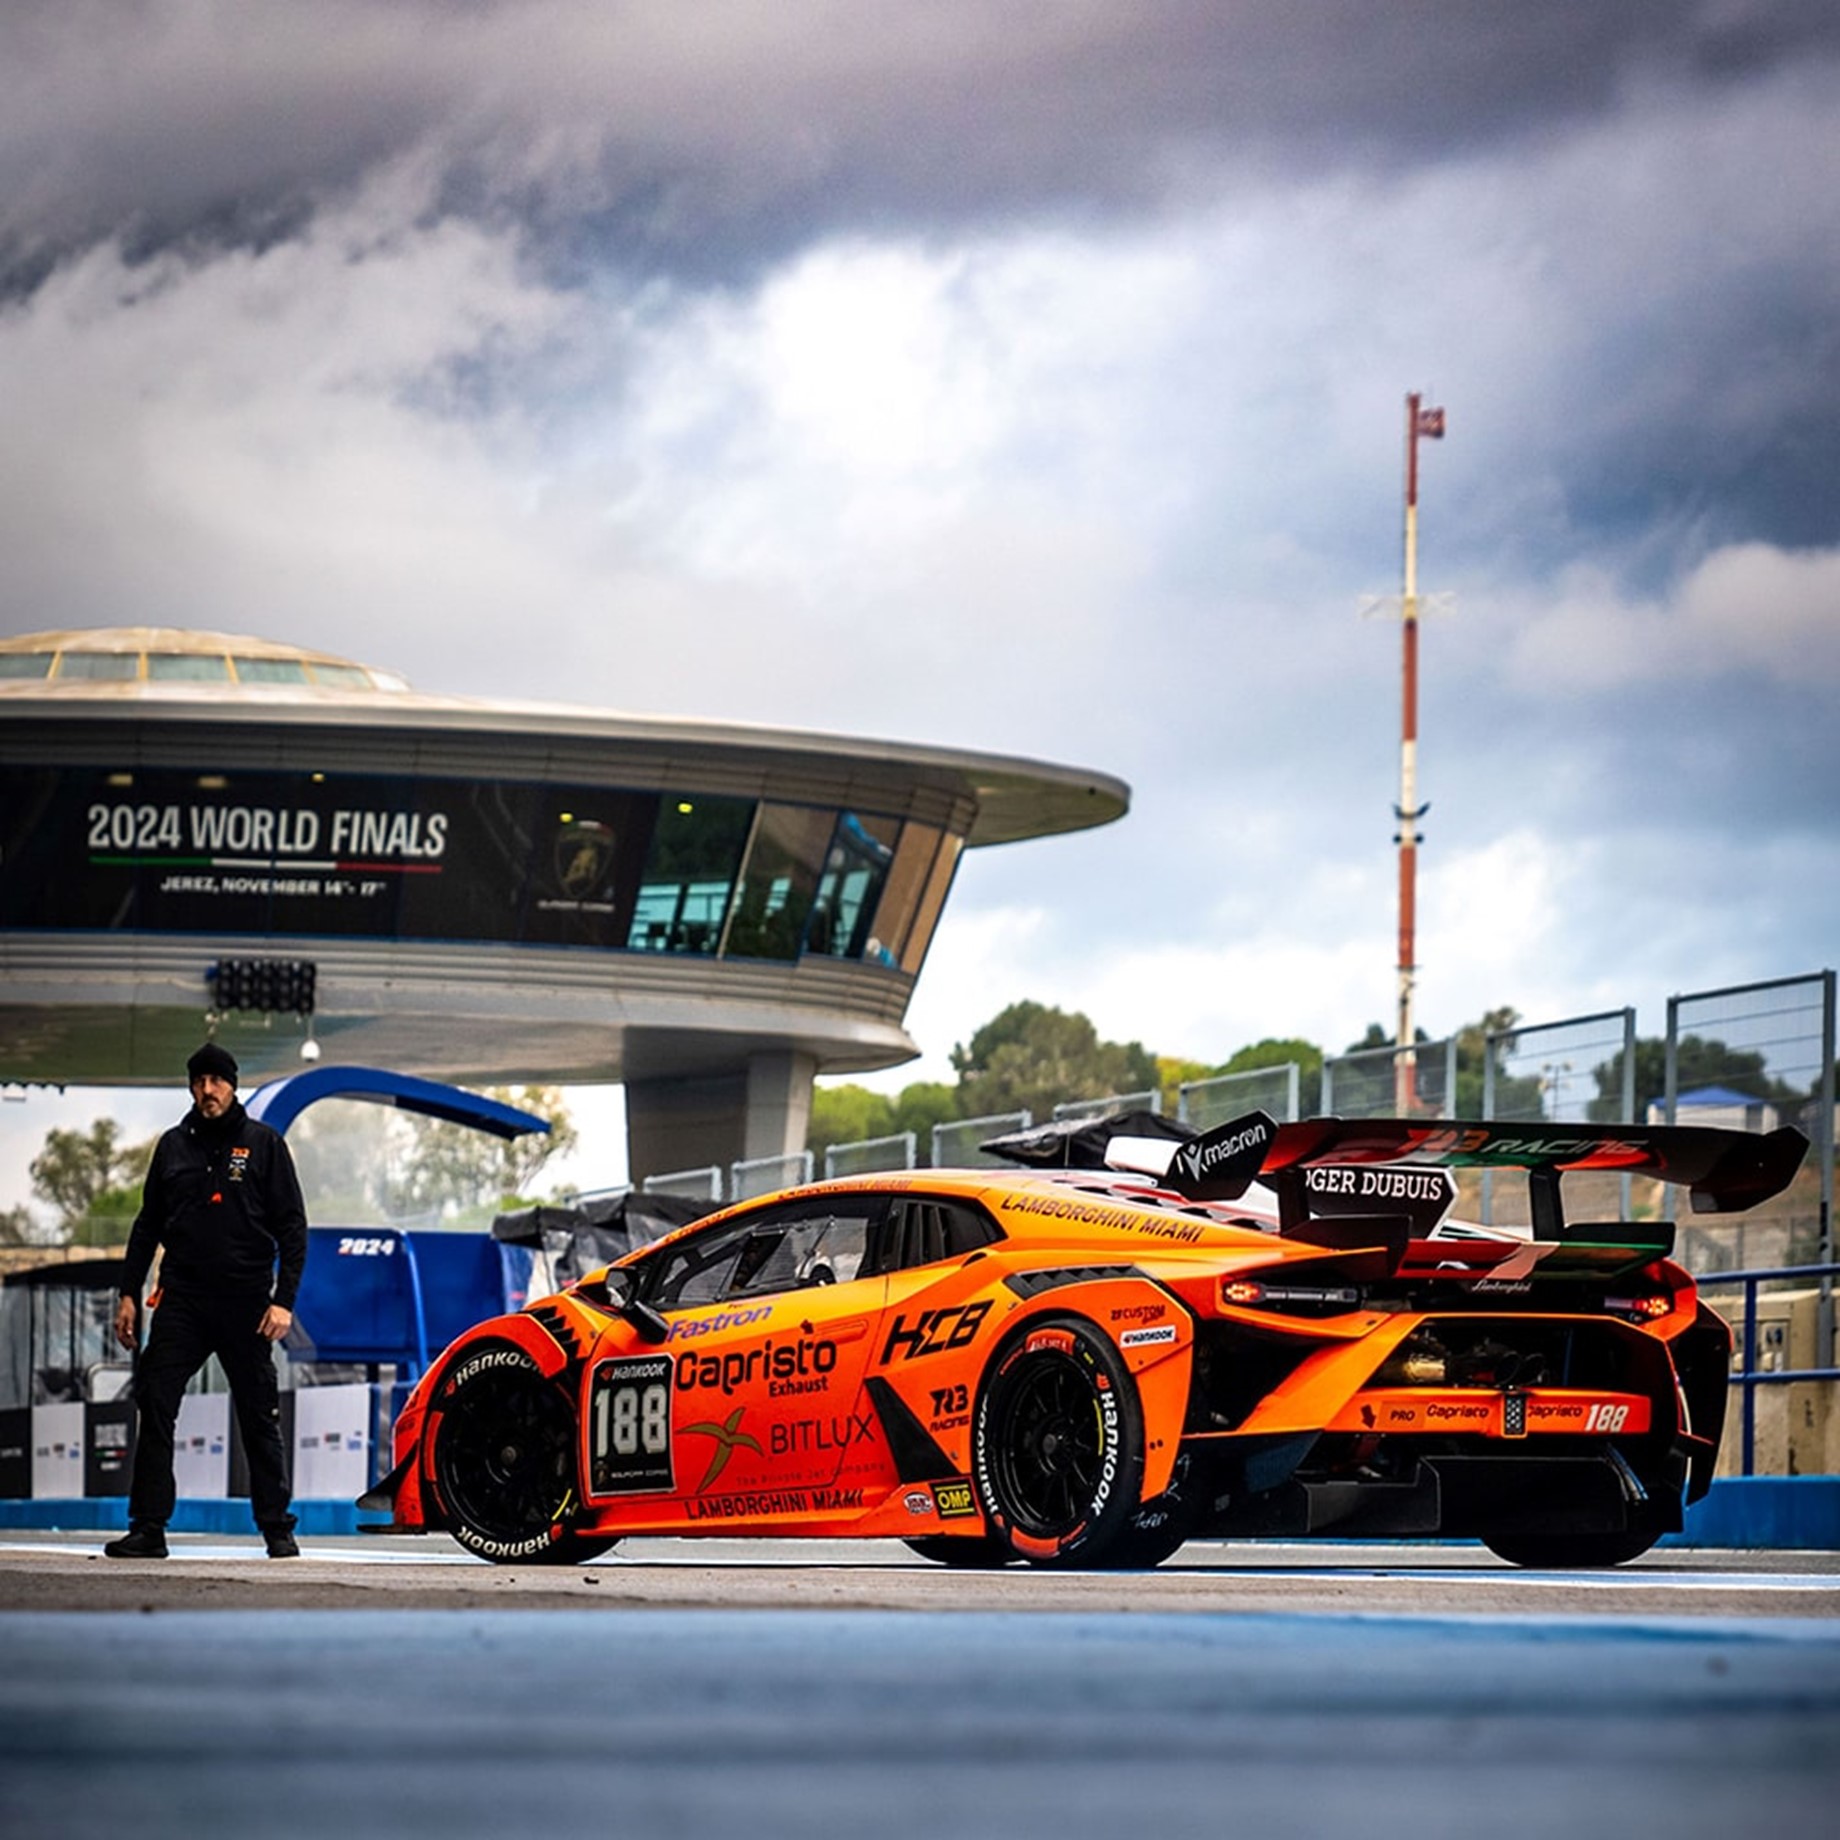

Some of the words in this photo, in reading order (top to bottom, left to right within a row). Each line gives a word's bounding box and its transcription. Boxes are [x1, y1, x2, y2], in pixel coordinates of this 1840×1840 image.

[88, 804, 181, 849] 2024
[190, 806, 319, 852] WORLD
[331, 810, 448, 857] FINALS
[221, 877, 320, 895] NOVEMBER
[1204, 1124, 1267, 1166] macron
[1360, 1171, 1443, 1200] DUBUIS
[1001, 1194, 1140, 1231] LAMBORGHINI
[1139, 1217, 1205, 1243] MIAMI
[338, 1237, 395, 1256] 2024
[667, 1305, 773, 1343] Fastron
[879, 1298, 996, 1366] HCB
[676, 1339, 837, 1396] Capristo
[768, 1375, 829, 1398] Exhaust
[594, 1384, 667, 1458] 188
[1390, 1409, 1416, 1422] PRO
[1426, 1403, 1490, 1420] Capristo
[1584, 1404, 1630, 1433] 188
[771, 1413, 875, 1454] BITLUX
[1090, 1391, 1119, 1517] Hankook
[684, 1493, 808, 1520] LAMBORGHINI
[812, 1489, 865, 1509] MIAMI
[937, 1490, 971, 1509] OMP
[457, 1525, 551, 1557] Hankook
